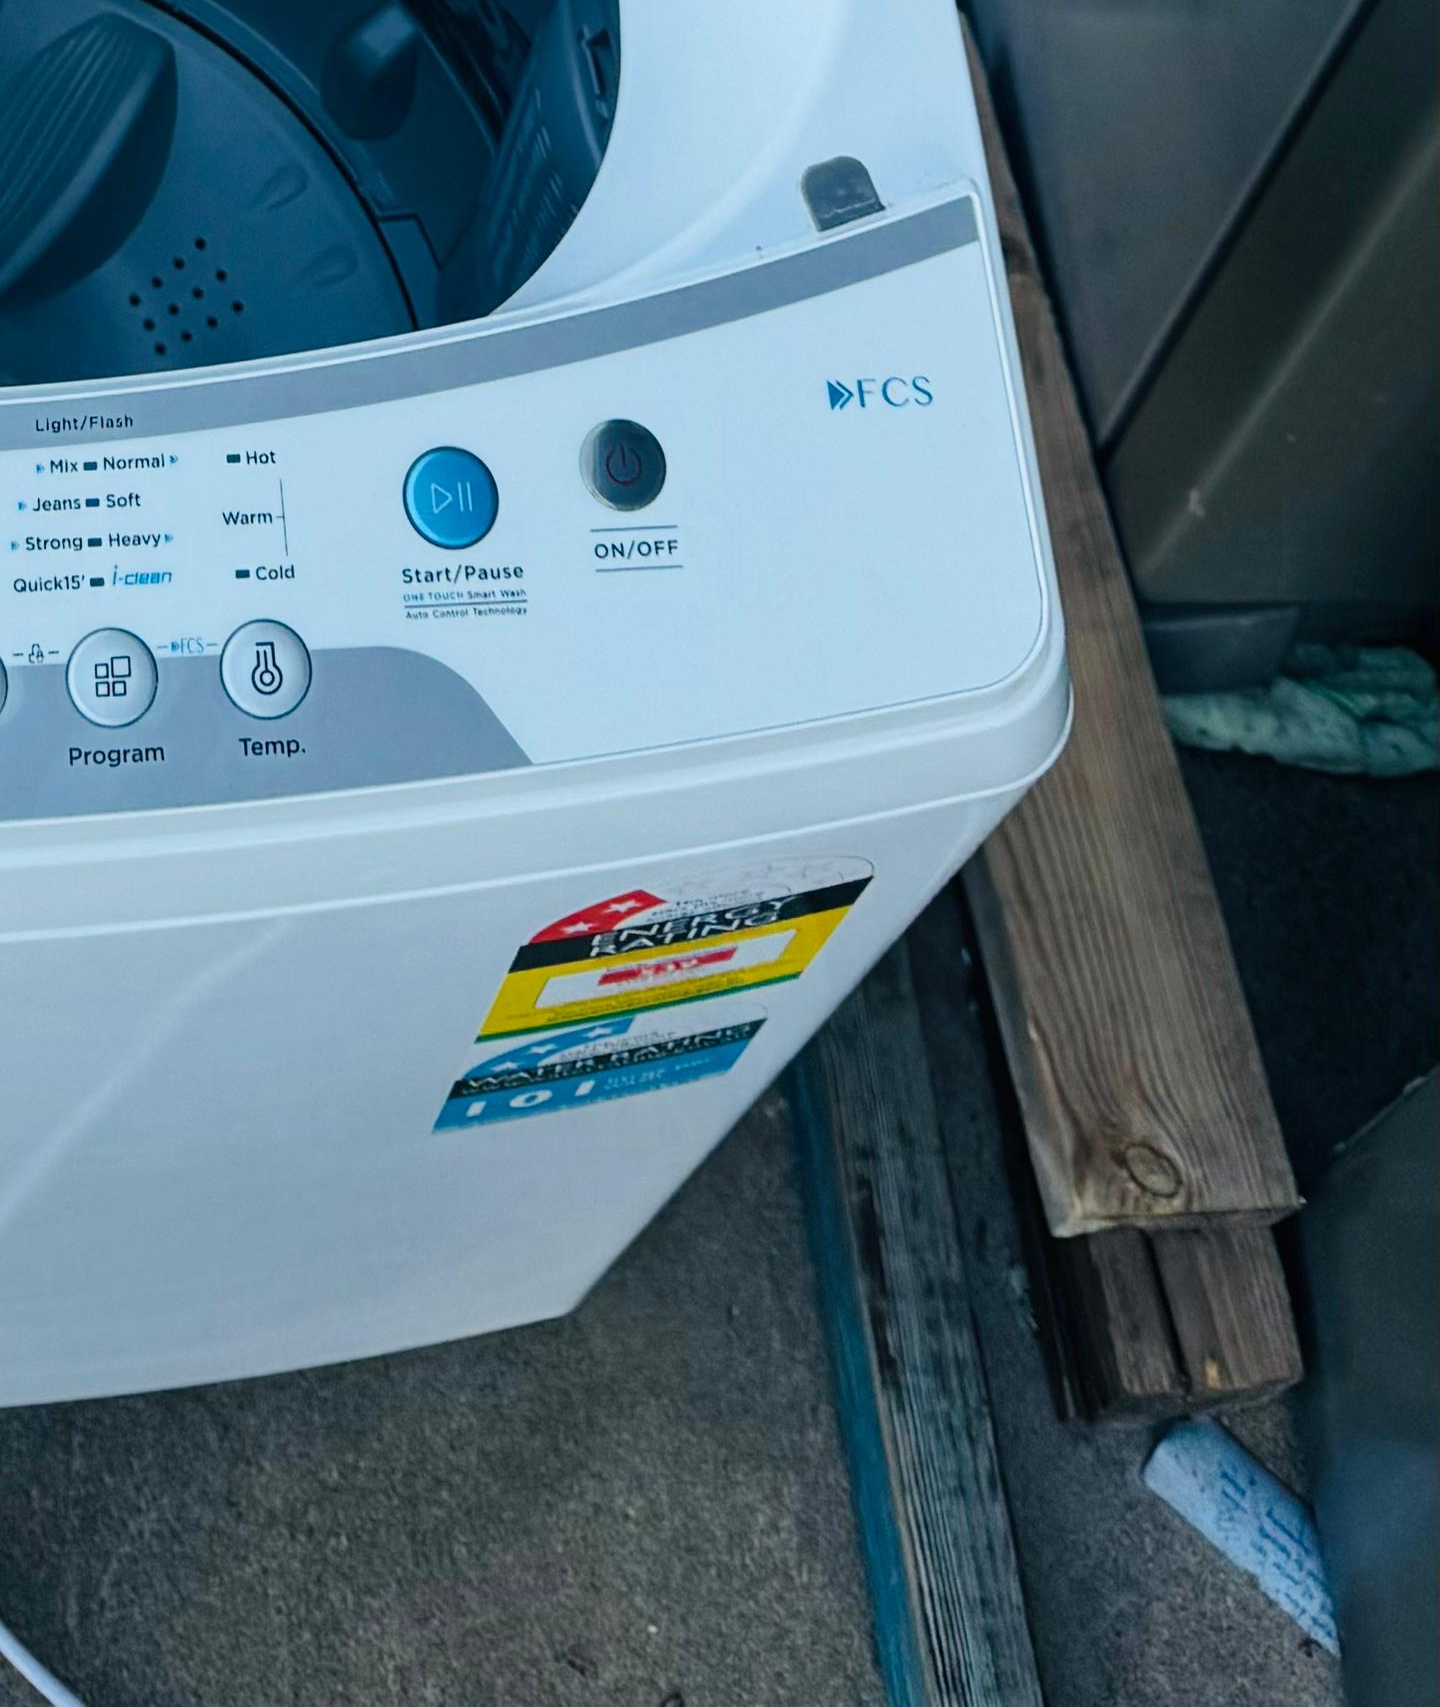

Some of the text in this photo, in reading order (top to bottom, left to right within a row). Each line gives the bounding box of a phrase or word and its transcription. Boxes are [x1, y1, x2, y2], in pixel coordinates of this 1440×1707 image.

[856, 375, 933, 408] FCS
[35, 414, 134, 433] Light/Flash
[103, 453, 165, 471] Normal
[245, 450, 276, 465] Hot
[50, 459, 78, 474] Mix
[32, 498, 81, 512] Jeans
[106, 492, 141, 508] Soft
[222, 511, 273, 526] Warm
[25, 536, 83, 551] Strong
[108, 532, 161, 548] Heavy
[594, 539, 679, 560] ON/OFF
[112, 565, 173, 586] i-clean
[255, 564, 296, 581] Cold
[401, 564, 525, 584] Start/Pause
[402, 588, 527, 602] ONE TOUCH Smart Wash
[405, 610, 429, 620] Auto
[432, 608, 469, 619] Control
[68, 744, 166, 768] Program
[238, 736, 307, 760] Temp.
[591, 895, 798, 946] ENERGY
